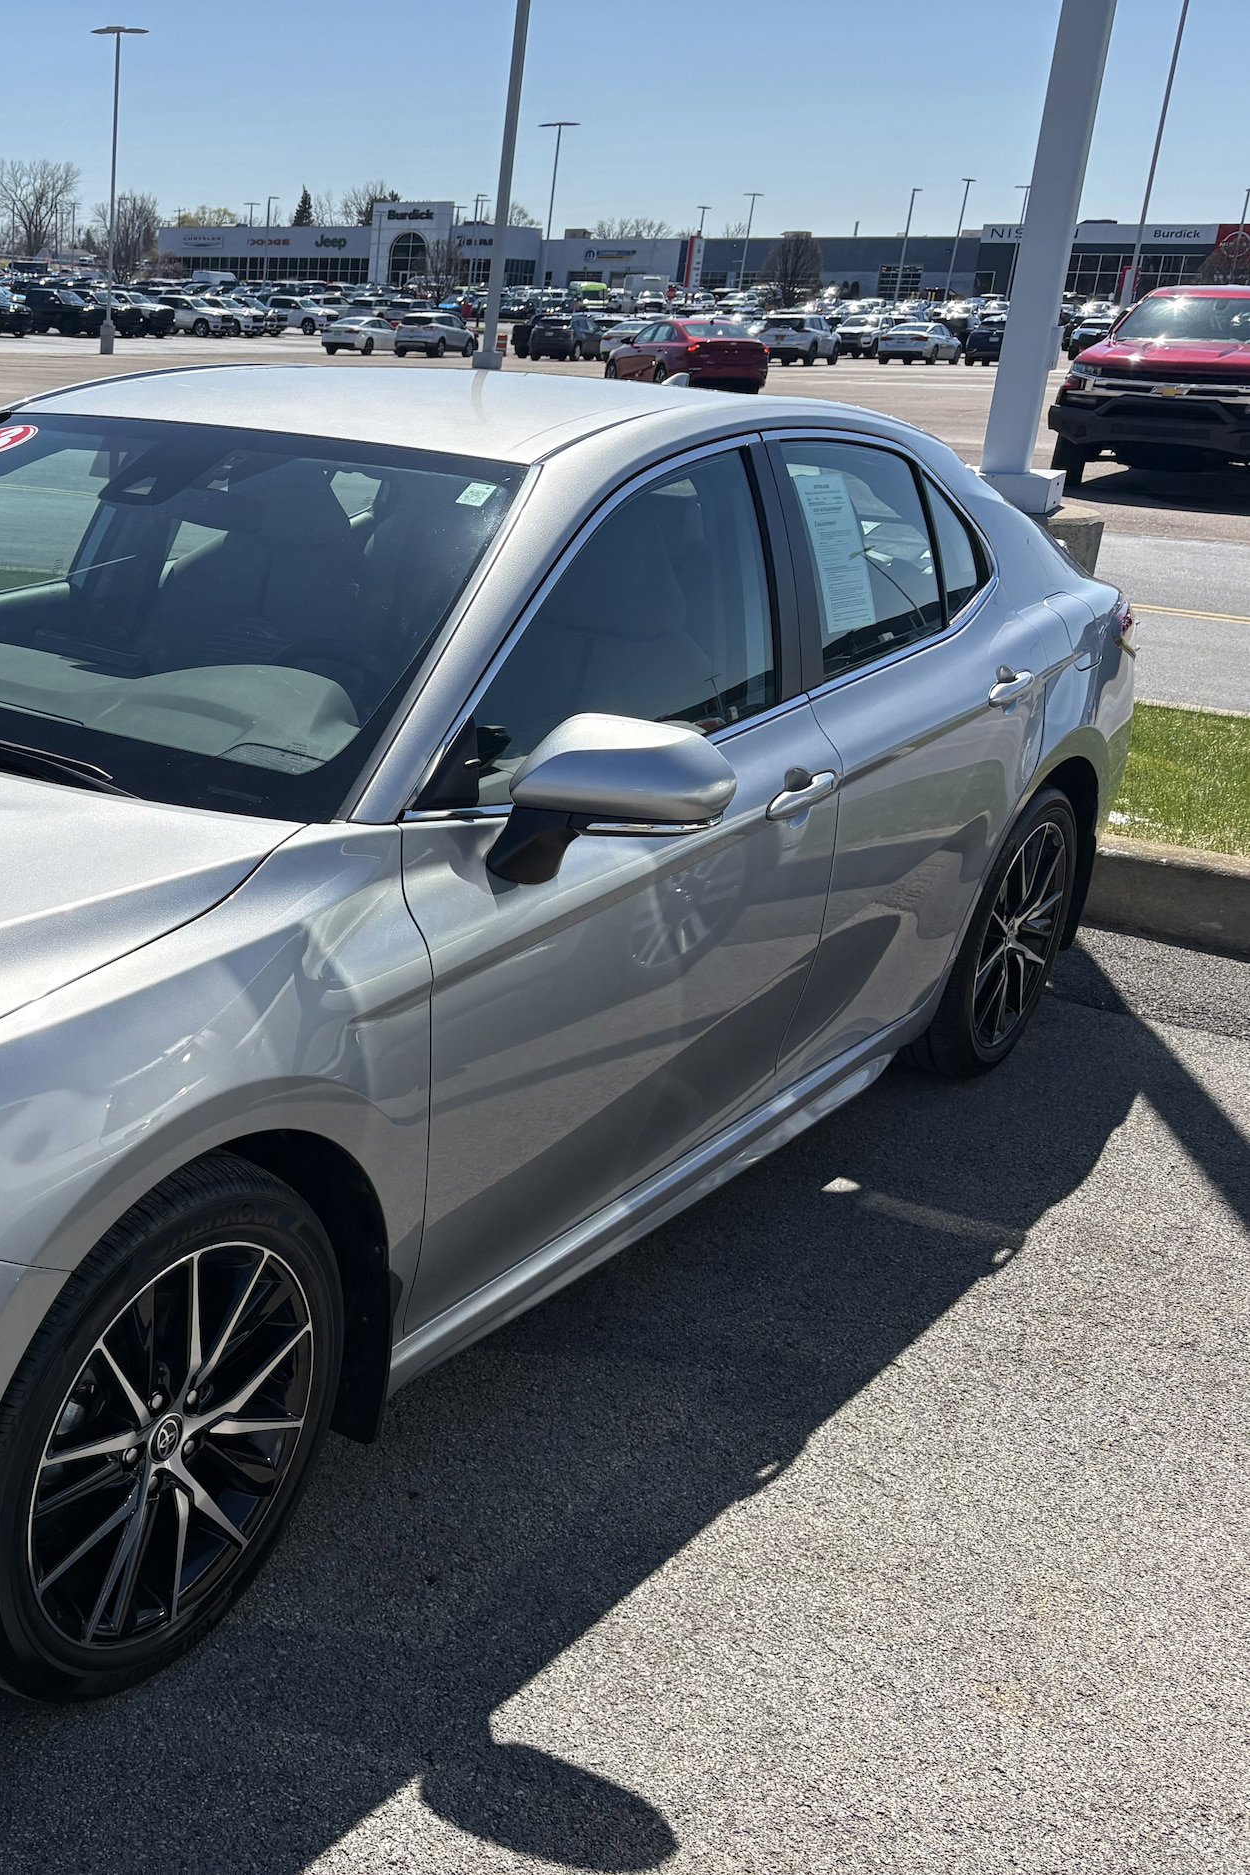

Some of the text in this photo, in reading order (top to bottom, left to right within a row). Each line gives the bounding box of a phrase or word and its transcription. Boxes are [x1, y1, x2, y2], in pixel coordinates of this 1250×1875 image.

[387, 209, 434, 220] Burdick
[1153, 229, 1201, 239] Burdick
[247, 238, 291, 246] DODGE
[315, 234, 347, 250] Jeep
